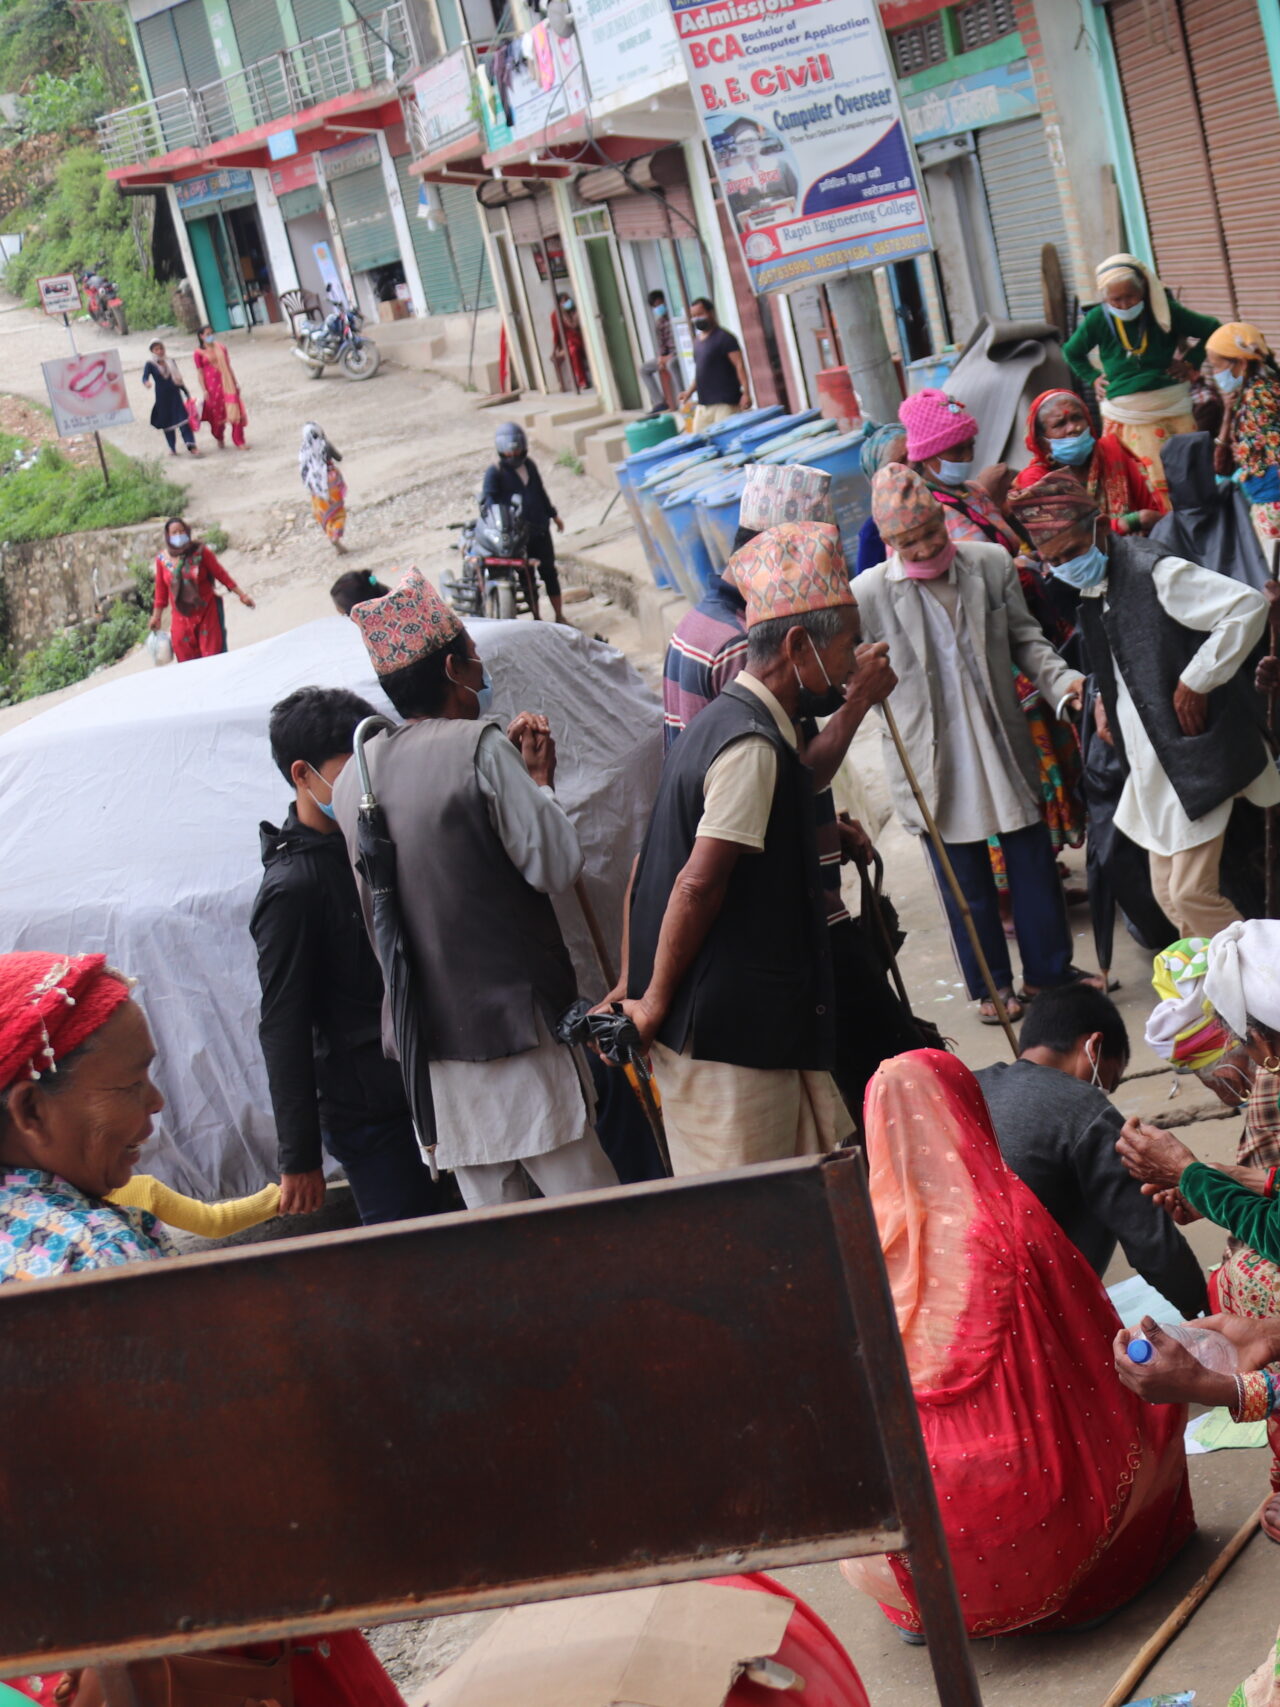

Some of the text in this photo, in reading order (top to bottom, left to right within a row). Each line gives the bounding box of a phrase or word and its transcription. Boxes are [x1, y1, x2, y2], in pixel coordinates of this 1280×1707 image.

[689, 34, 745, 68] BCA
[741, 20, 797, 43] Bachelor of
[745, 16, 870, 56] Computer Application
[701, 53, 835, 110] B. E. Civil
[773, 102, 832, 131] Computer
[835, 88, 892, 116] Overseer
[782, 200, 916, 242] Rapti Engineering College
